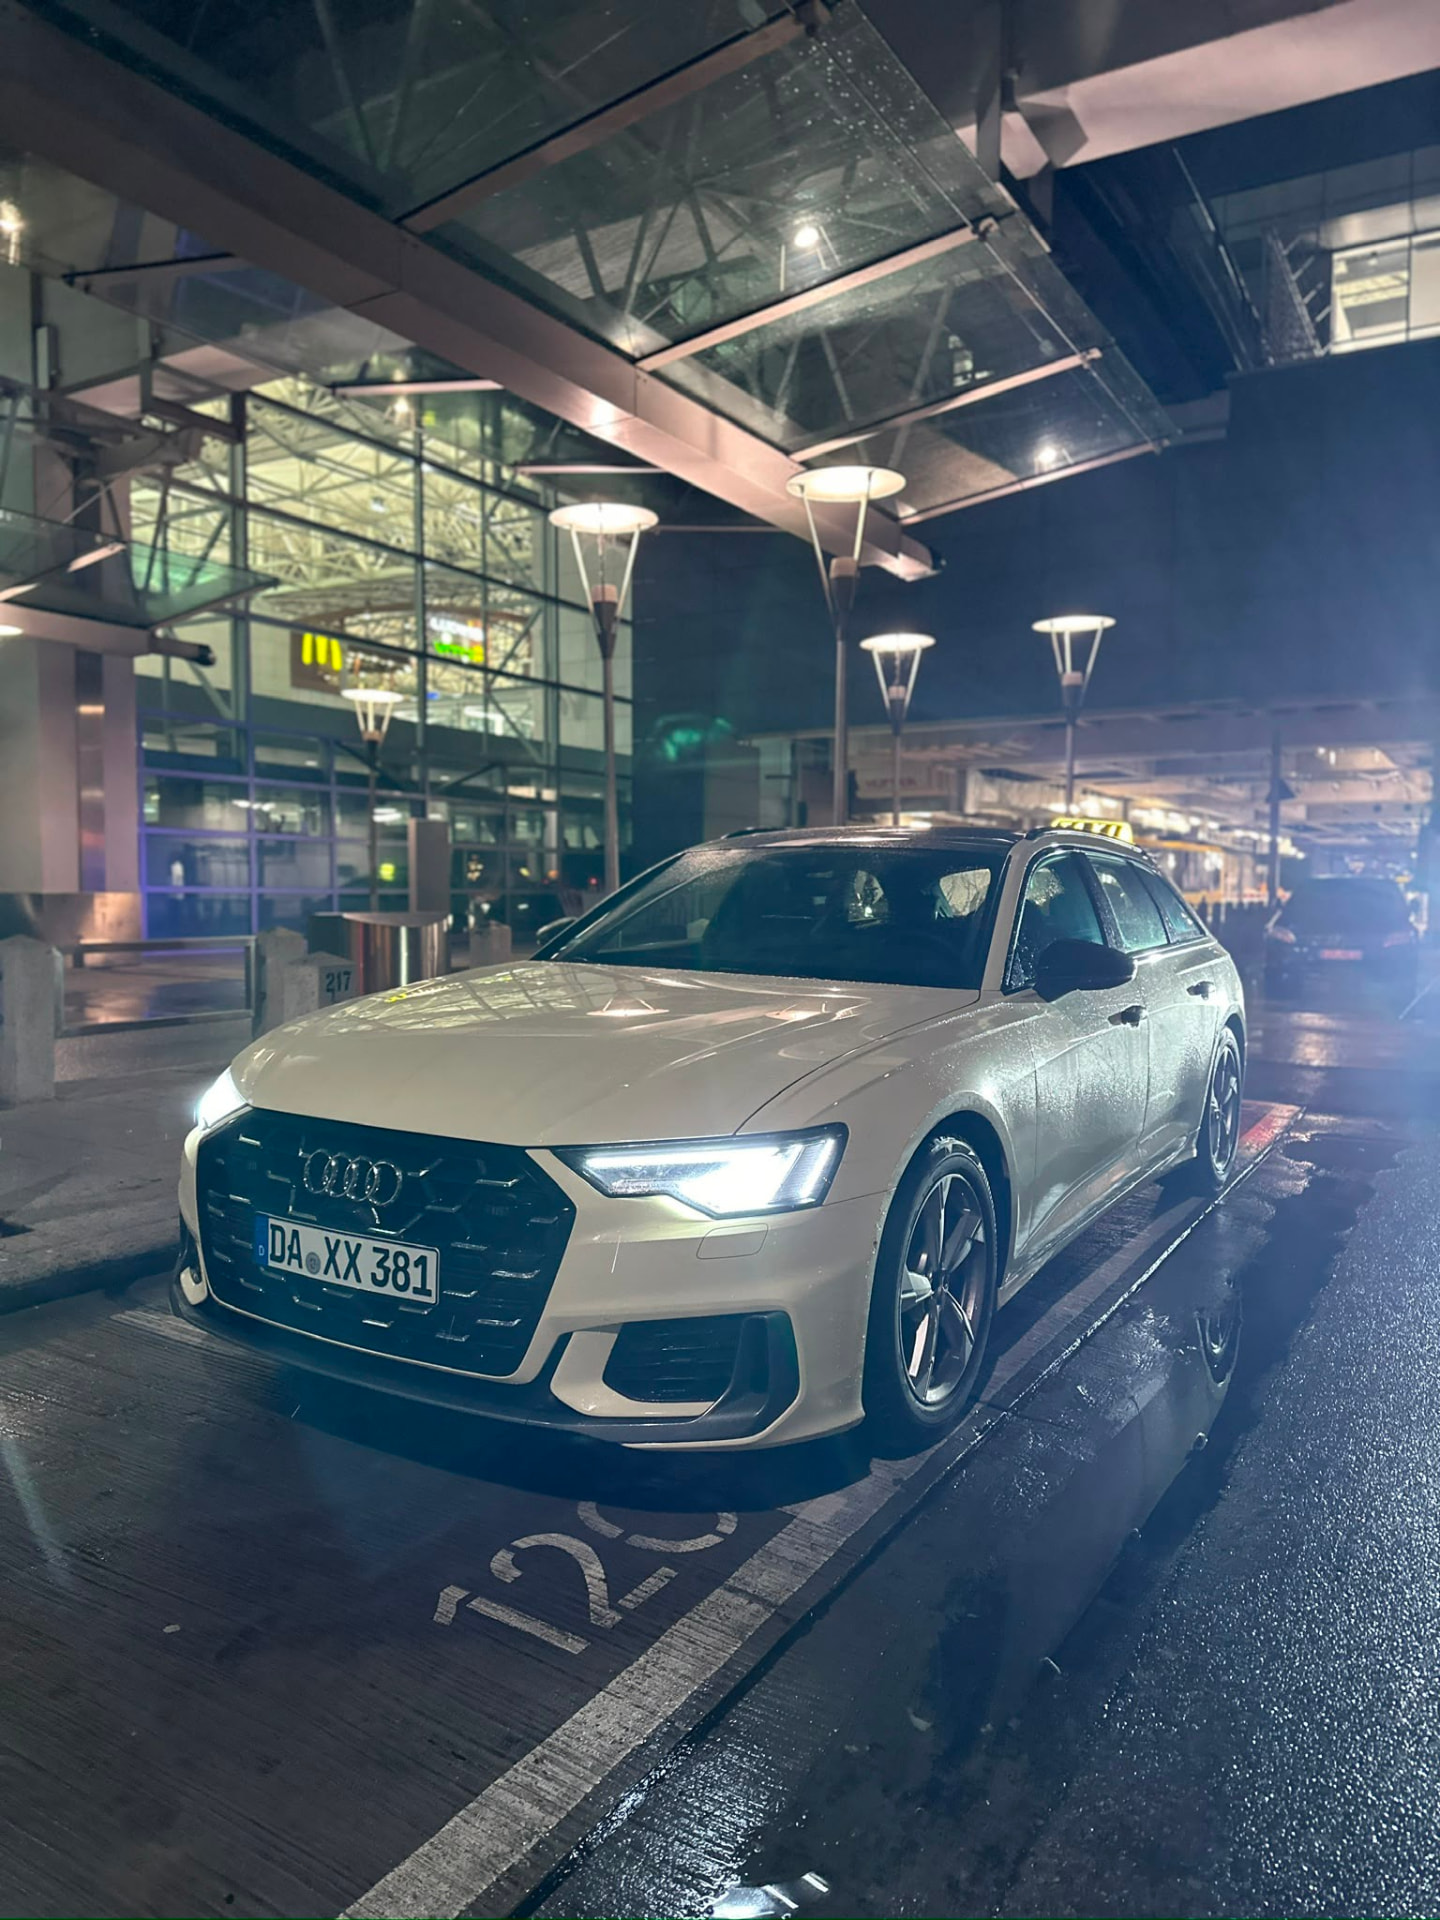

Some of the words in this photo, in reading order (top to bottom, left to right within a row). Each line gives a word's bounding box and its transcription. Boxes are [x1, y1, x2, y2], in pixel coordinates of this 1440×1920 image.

[326, 971, 352, 993] 217
[270, 1224, 303, 1269] DA
[323, 1236, 362, 1283] XX
[371, 1246, 432, 1297] 381
